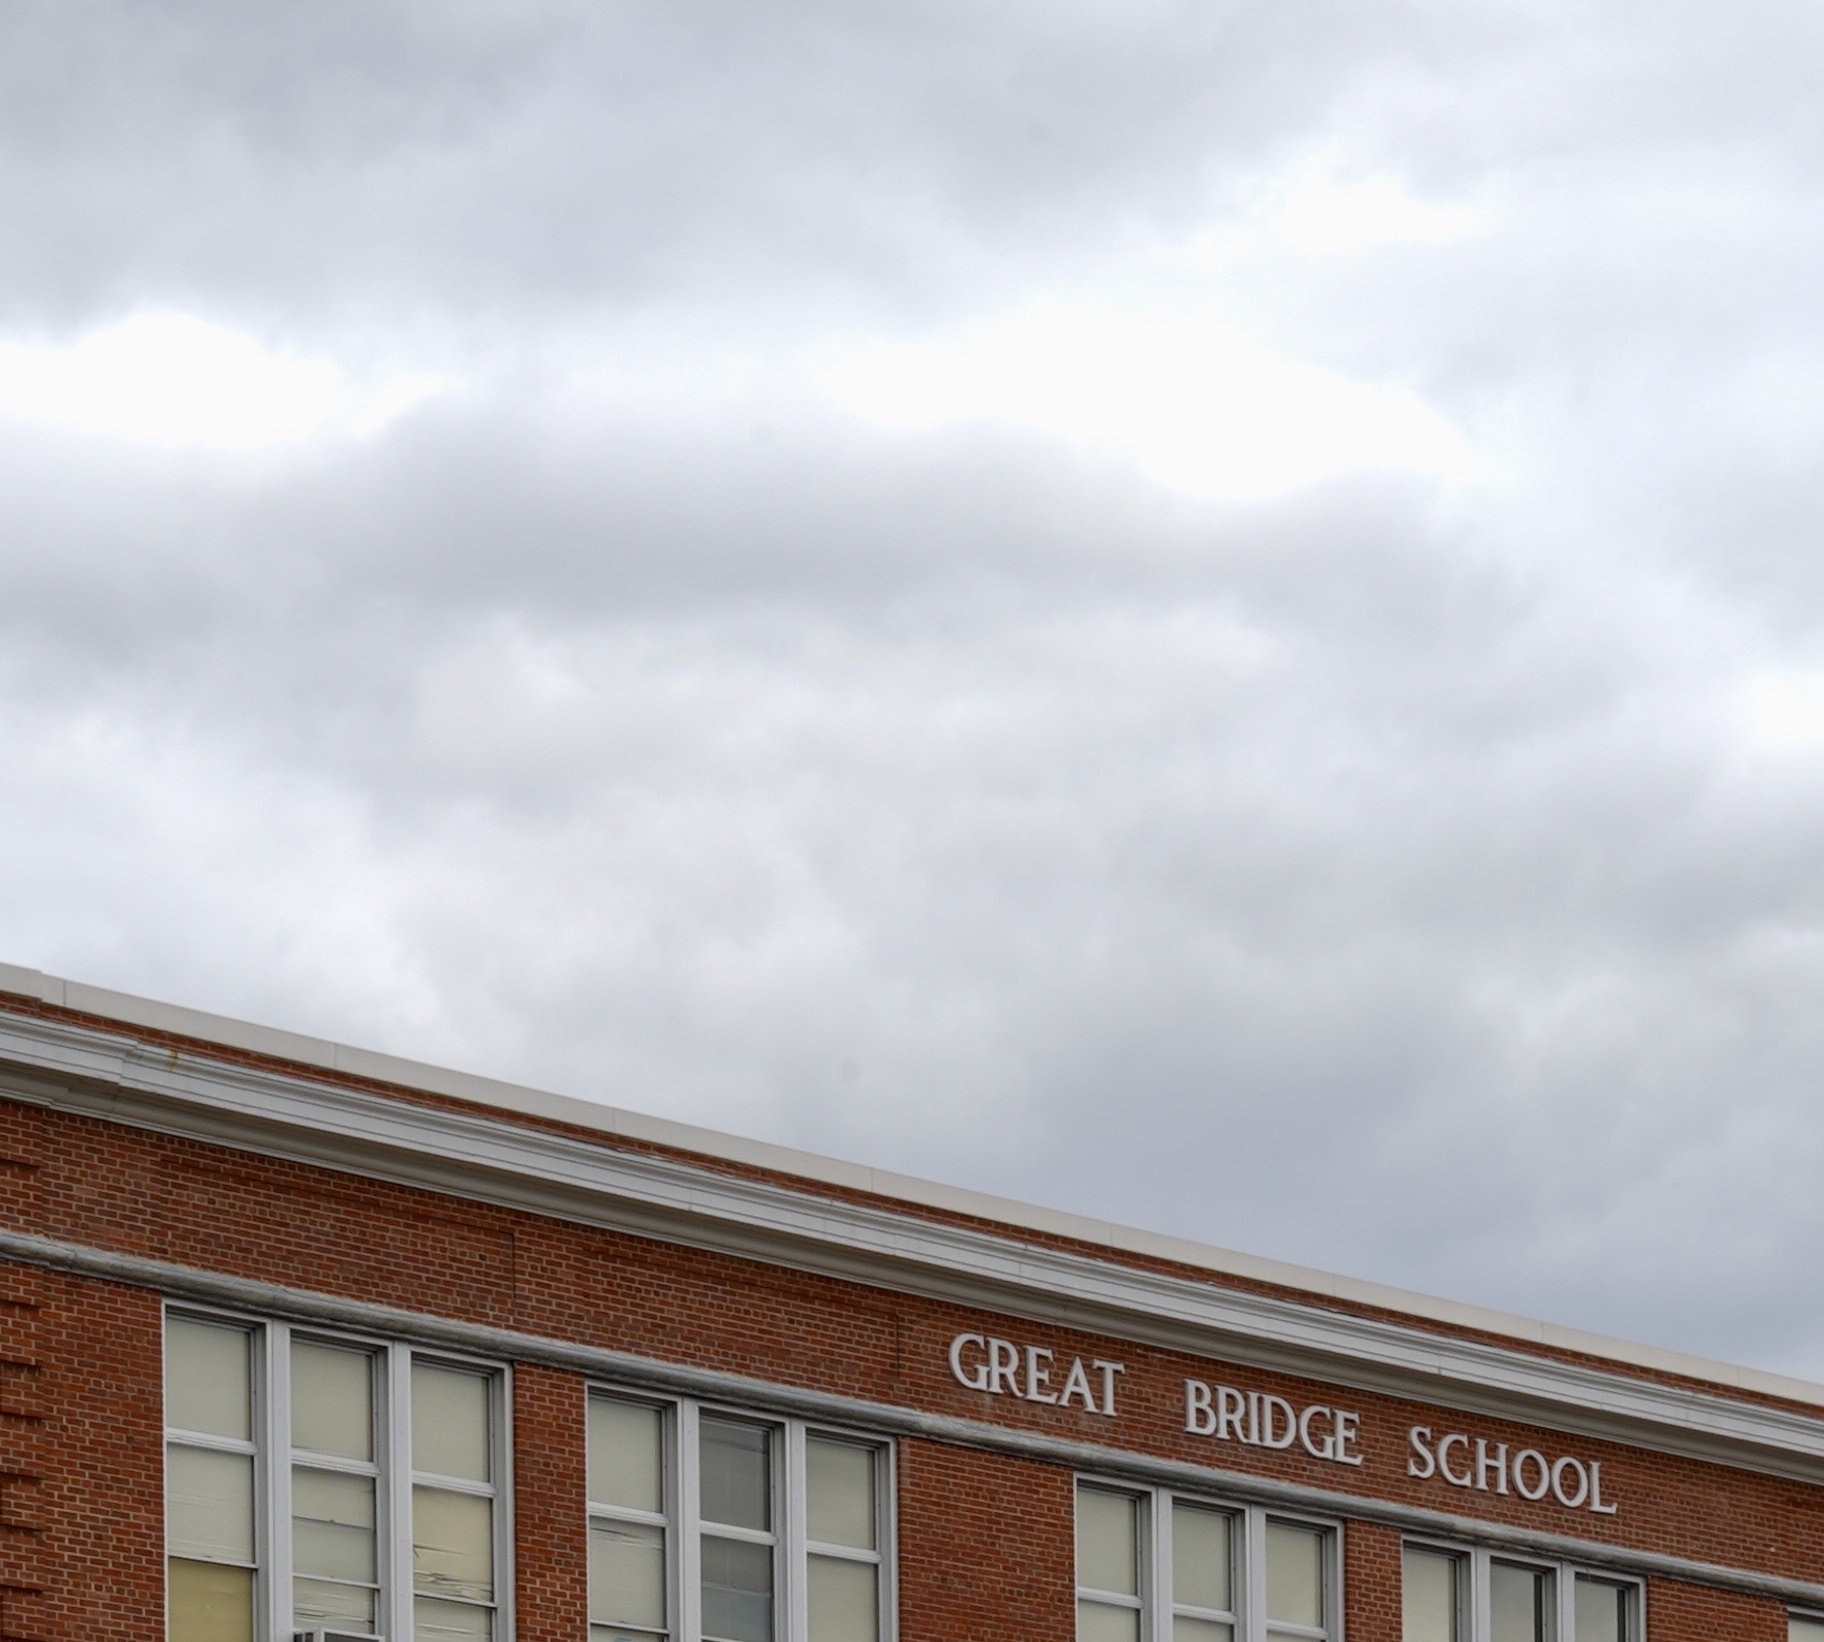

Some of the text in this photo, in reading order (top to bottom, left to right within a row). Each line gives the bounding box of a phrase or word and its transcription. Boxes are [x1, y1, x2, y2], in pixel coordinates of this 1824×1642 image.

[948, 1333, 1618, 1515] GREAT BRIDGE SCHOOL
